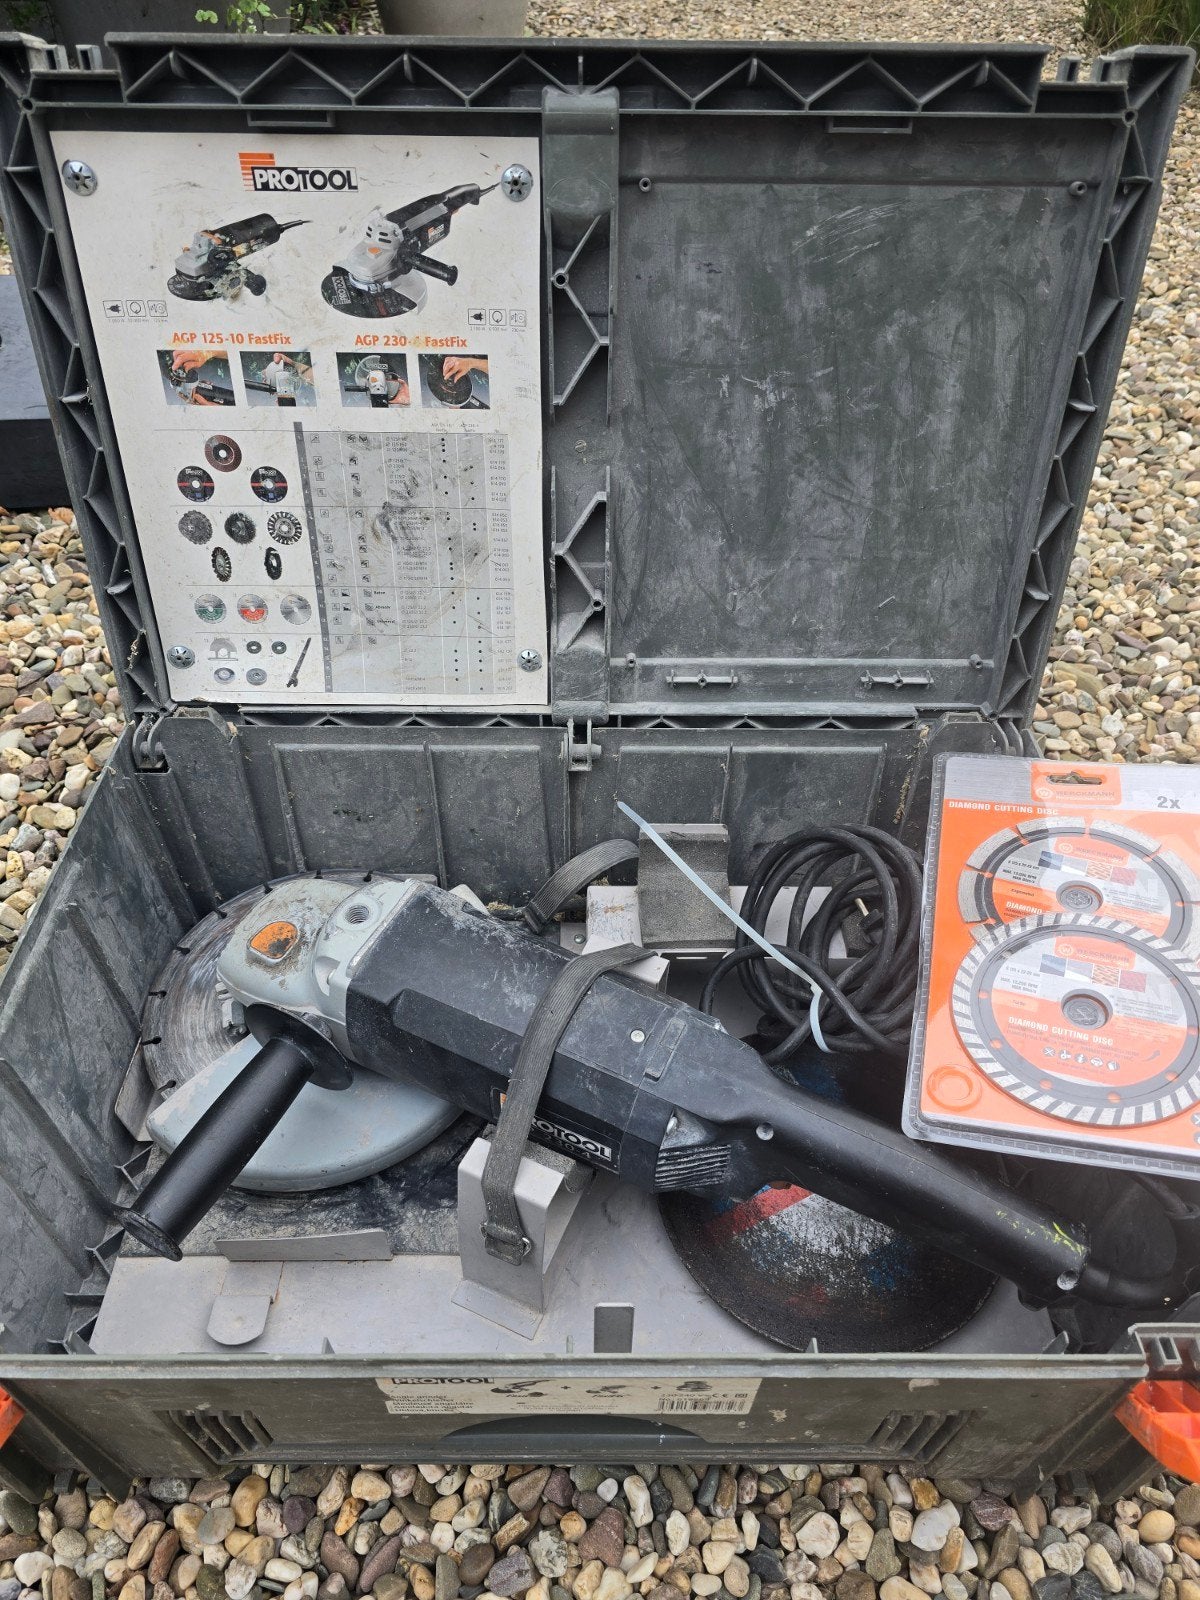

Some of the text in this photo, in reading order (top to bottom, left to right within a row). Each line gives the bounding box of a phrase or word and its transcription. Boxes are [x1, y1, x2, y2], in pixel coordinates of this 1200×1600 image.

[253, 167, 358, 190] PROTOOL
[172, 332, 292, 345] AGP 125-10 FastFix
[354, 334, 379, 346] AGP
[424, 335, 468, 347] FastFix
[949, 801, 1058, 815] DIAMOND CUTTING DISC
[1157, 796, 1182, 810] 2x
[1006, 901, 1043, 914] DIAMOND
[1008, 1016, 1114, 1046] DIAMOND CUTTING DISC
[531, 1117, 612, 1160] OTOOL
